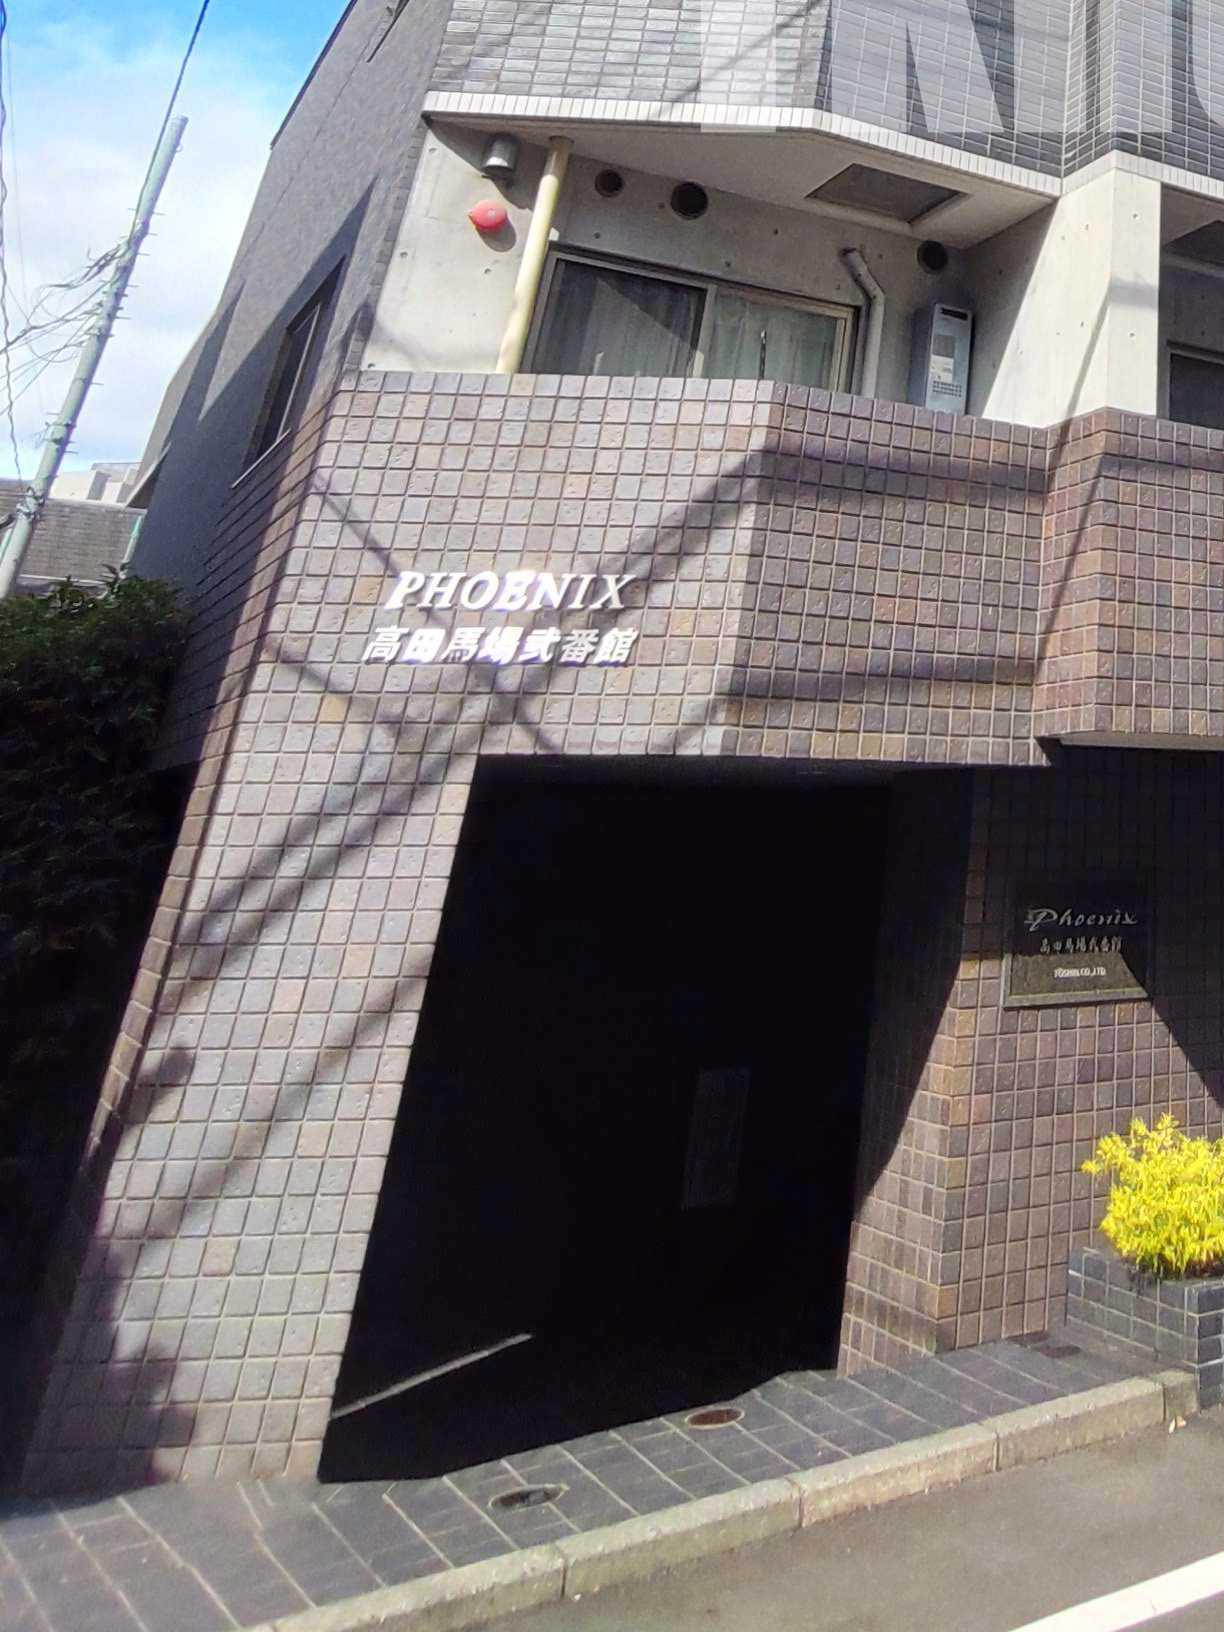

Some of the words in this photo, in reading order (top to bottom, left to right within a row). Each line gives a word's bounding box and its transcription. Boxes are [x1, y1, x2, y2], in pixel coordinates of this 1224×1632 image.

[384, 570, 636, 611] PHOENIX
[364, 625, 638, 666] 高田馬場弐番館
[1024, 908, 1137, 932] Phoenix
